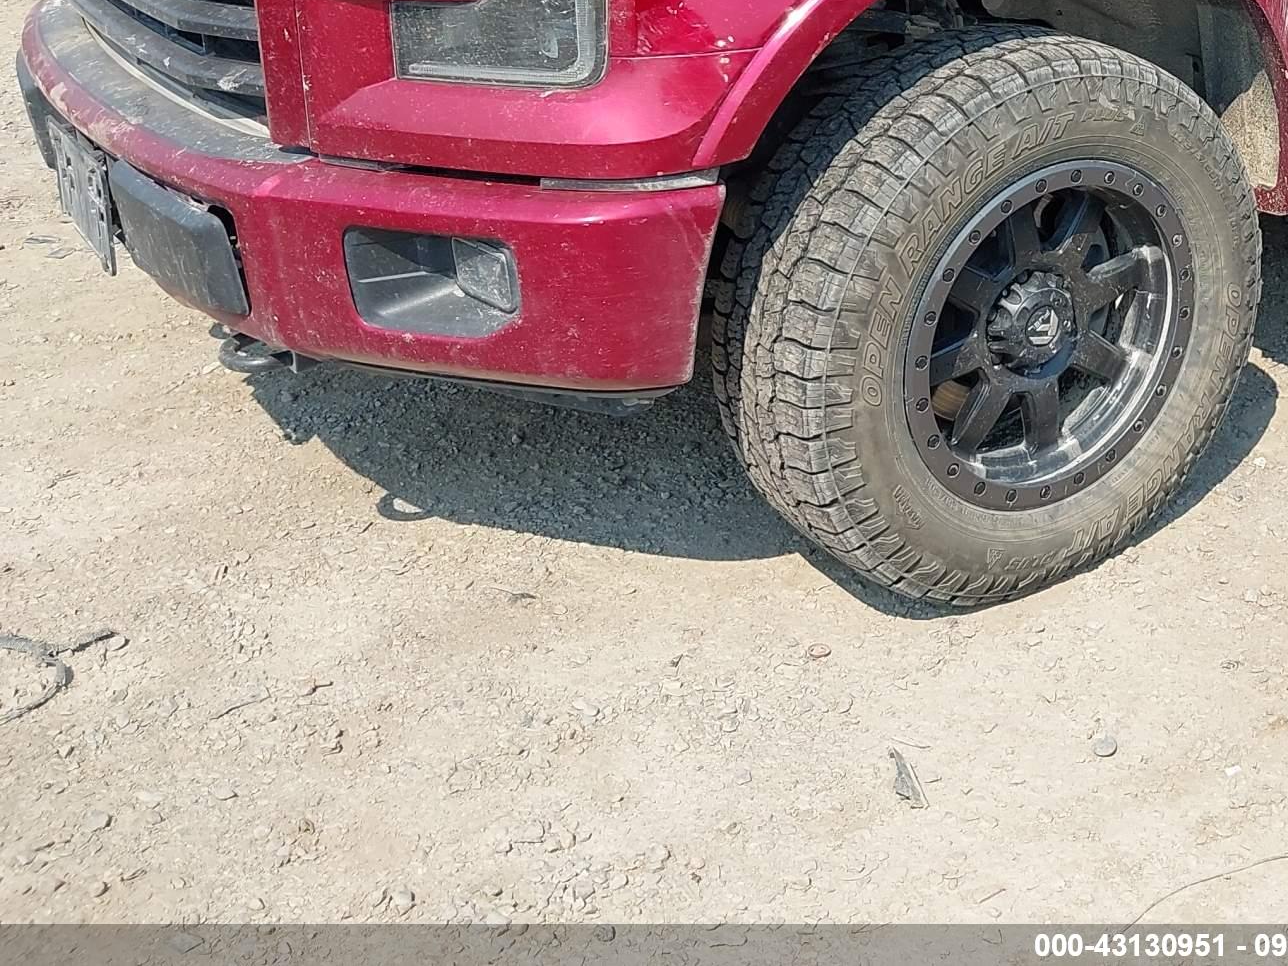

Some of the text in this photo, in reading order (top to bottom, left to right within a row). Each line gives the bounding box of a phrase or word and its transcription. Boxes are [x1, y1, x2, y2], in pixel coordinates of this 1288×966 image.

[862, 275, 904, 407] OPEN
[899, 141, 1008, 279] RANGE
[1012, 112, 1076, 160] A/T
[1210, 281, 1242, 392] OPEN
[1126, 390, 1213, 523] RANGE
